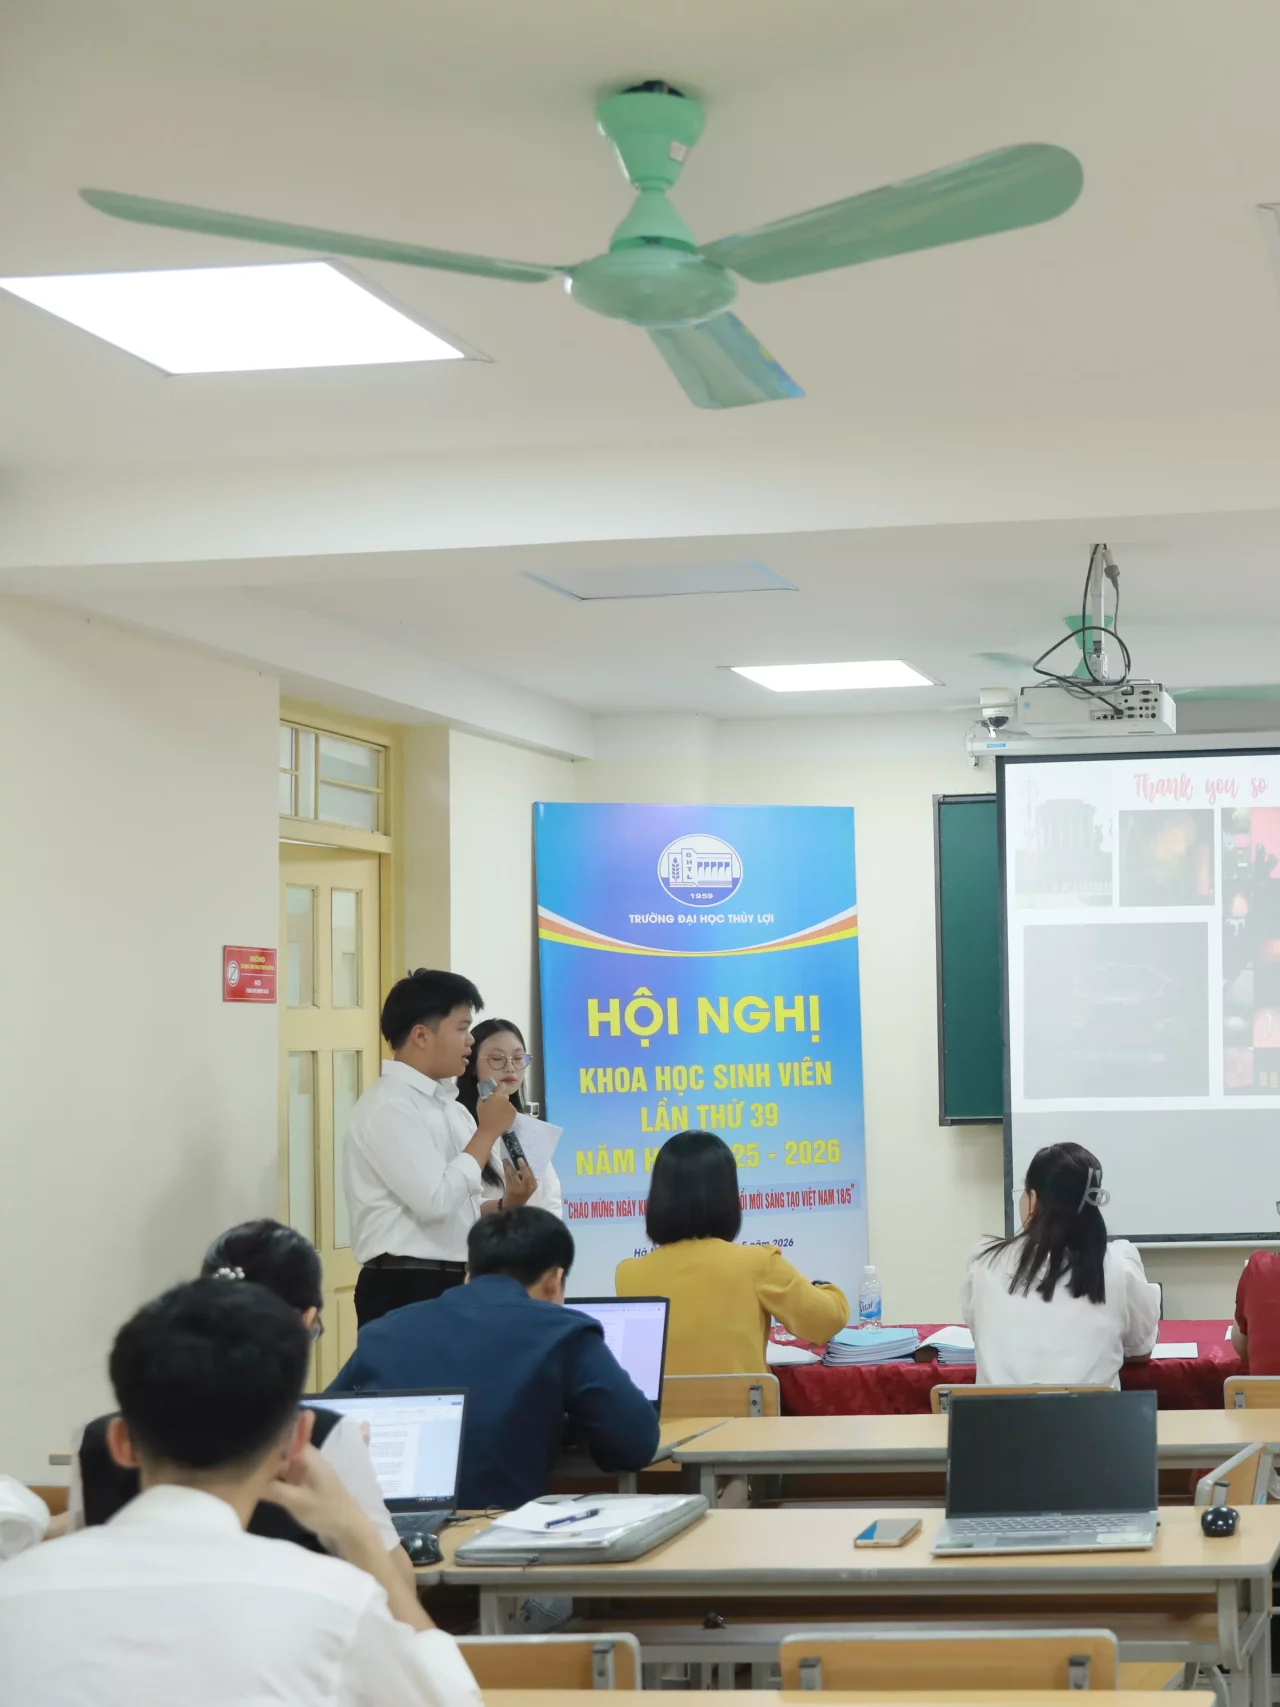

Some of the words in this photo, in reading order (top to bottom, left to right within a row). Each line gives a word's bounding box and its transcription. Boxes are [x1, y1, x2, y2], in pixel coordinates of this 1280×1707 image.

[1134, 772, 1193, 803] Thank
[1205, 776, 1239, 805] you
[1250, 777, 1268, 798] so
[629, 912, 674, 923] TRƯỜNG
[678, 914, 697, 926] ĐẠI
[701, 914, 725, 926] HỌC
[728, 911, 754, 923] THỦY
[757, 913, 774, 926] LỢI
[587, 986, 679, 1048] HỘI
[697, 994, 820, 1043] NGHỊ
[579, 1067, 648, 1094] KHOA
[655, 1064, 704, 1096] HỌC
[713, 1062, 770, 1089] SINH
[777, 1056, 832, 1086] VIÊN
[640, 1097, 689, 1132] LẦN
[696, 1098, 744, 1130] THỨ
[750, 1102, 779, 1128] 39
[575, 1144, 635, 1176] NĂM
[731, 1142, 760, 1169] 25
[784, 1139, 841, 1165] 2026
[591, 1198, 614, 1218] MỪNG
[616, 1197, 636, 1217] NGÀY
[749, 1190, 763, 1210] MỚI
[765, 1189, 784, 1209] SÁNG
[786, 1191, 799, 1211] TẠO
[801, 1187, 816, 1210] VIỆT
[818, 1188, 835, 1205] NAM
[772, 1238, 794, 1247] 2026
